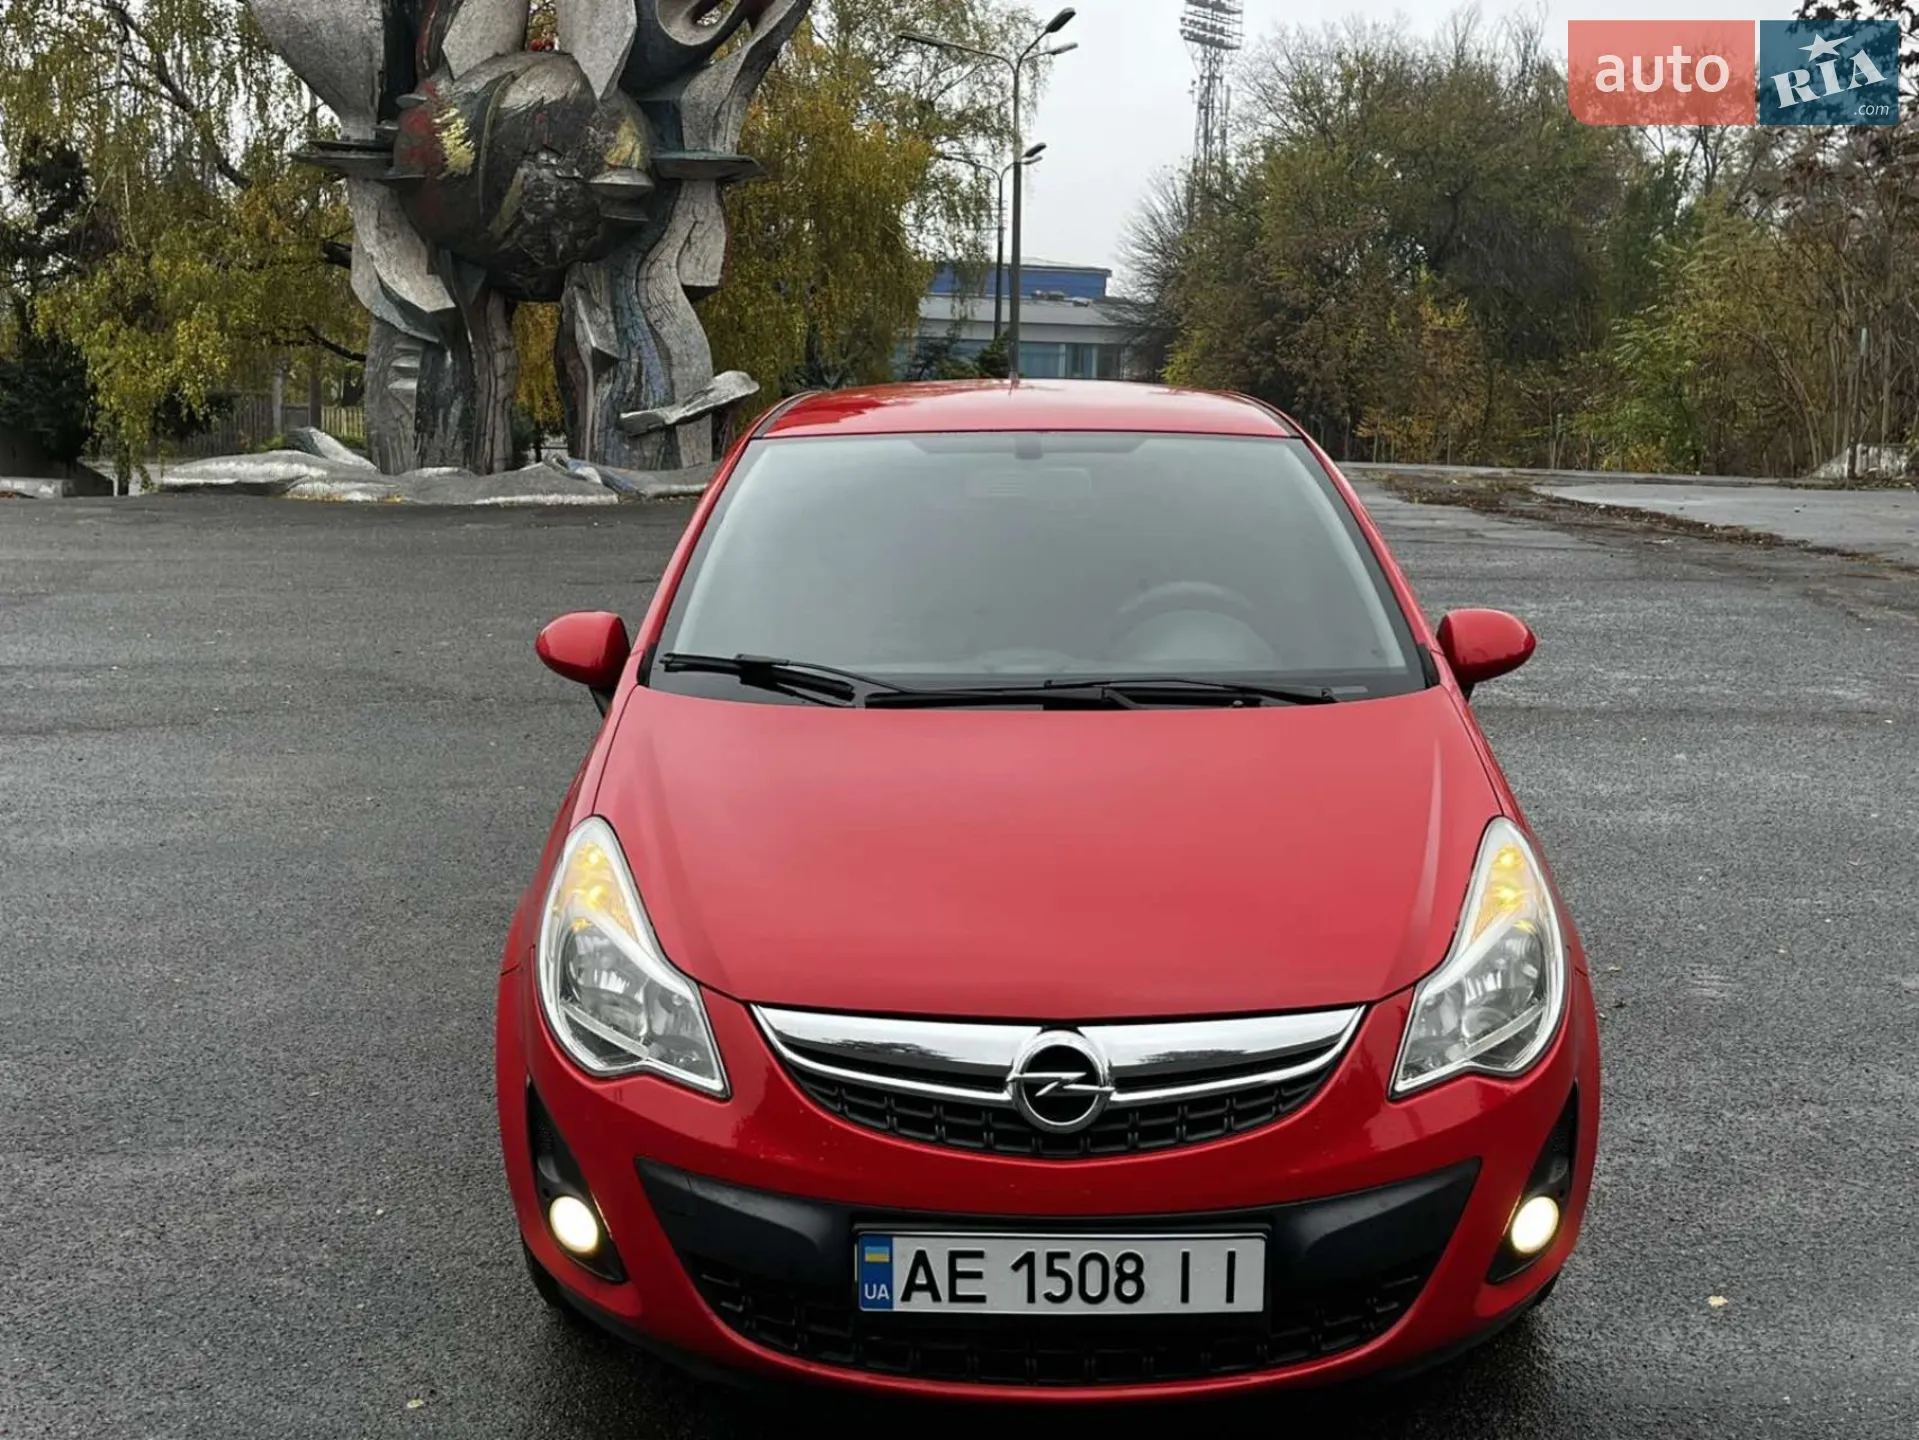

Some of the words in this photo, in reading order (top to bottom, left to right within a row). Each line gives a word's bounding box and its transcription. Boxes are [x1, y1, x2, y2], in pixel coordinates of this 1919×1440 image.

[864, 1283, 890, 1300] UA
[900, 1249, 987, 1304] AE
[1010, 1250, 1145, 1305] 1508
